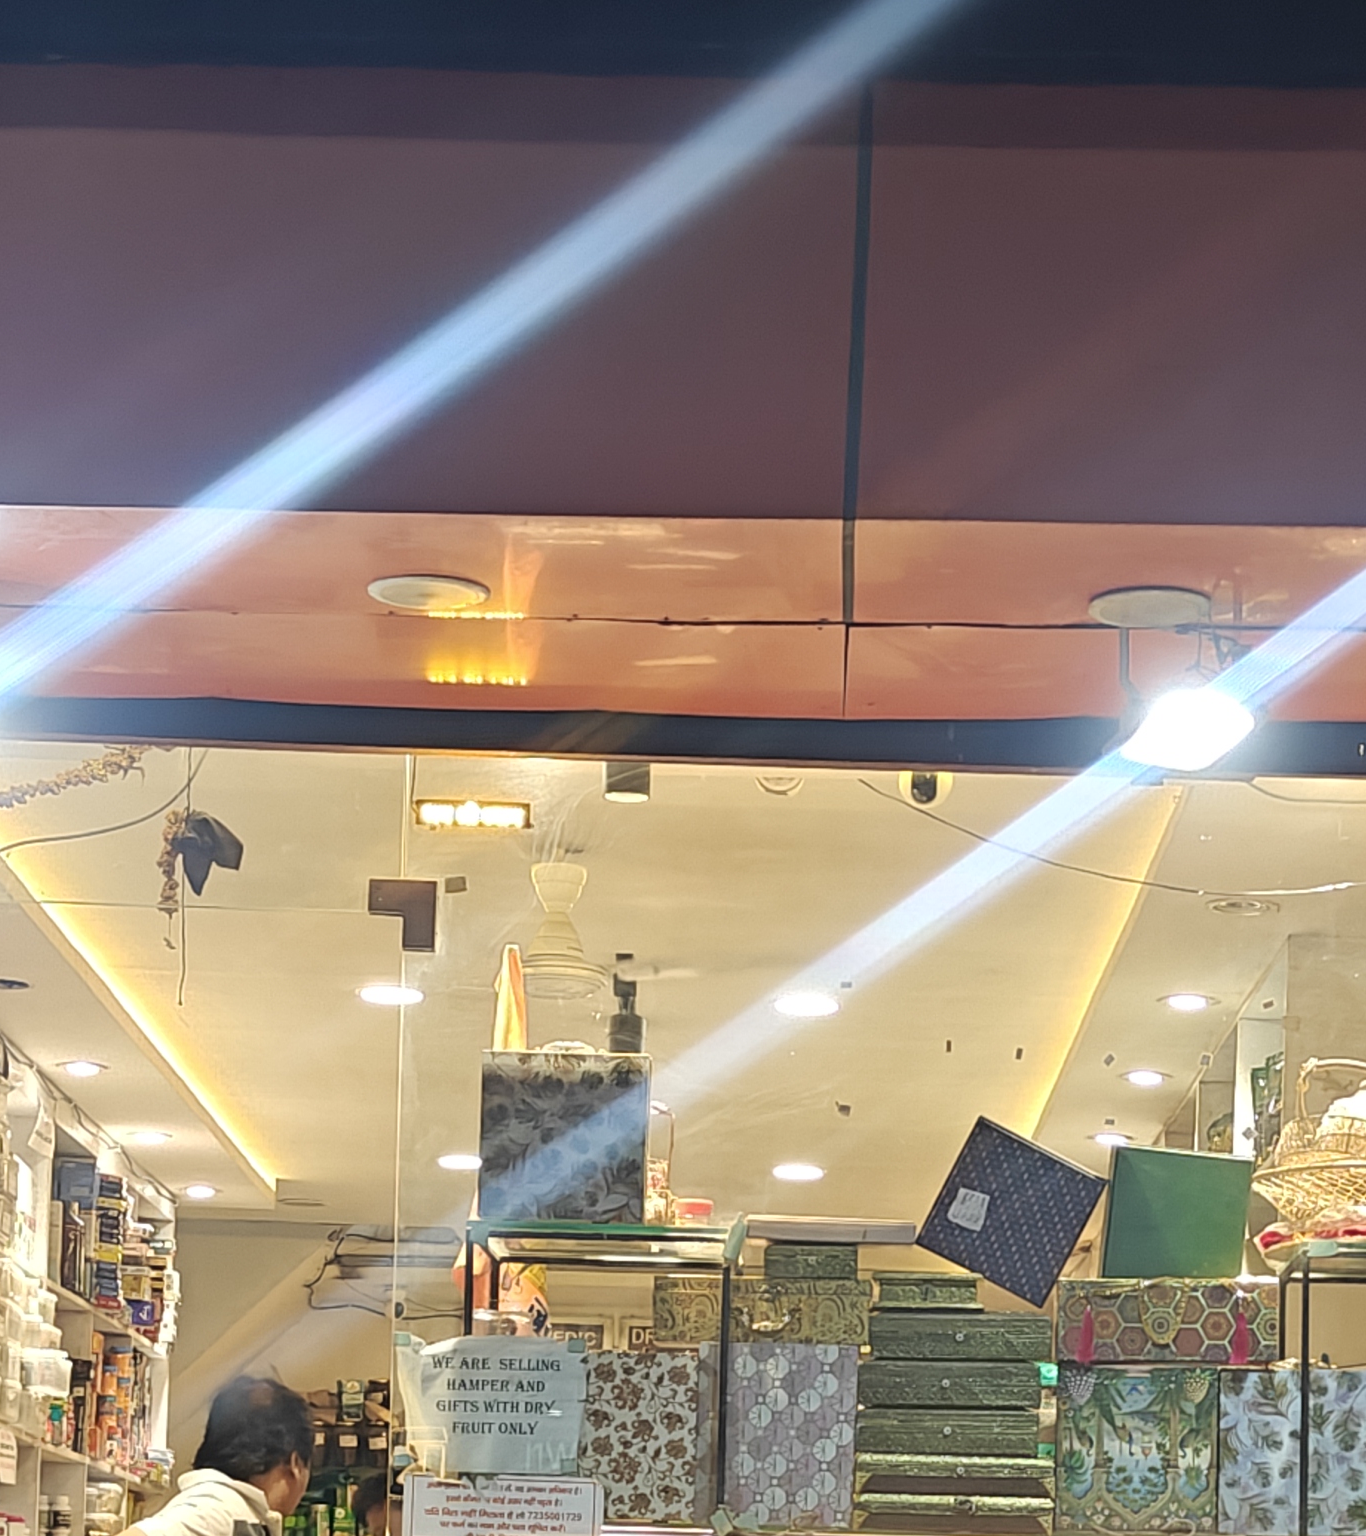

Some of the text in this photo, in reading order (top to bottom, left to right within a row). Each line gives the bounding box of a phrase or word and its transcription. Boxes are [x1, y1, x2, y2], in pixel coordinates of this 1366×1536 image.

[432, 1357, 561, 1372] WE ARE SELLING
[447, 1378, 545, 1392] HAMPER AND
[436, 1400, 556, 1414] GIFTS WITH DRY
[453, 1422, 539, 1435] FRUIT ONLY
